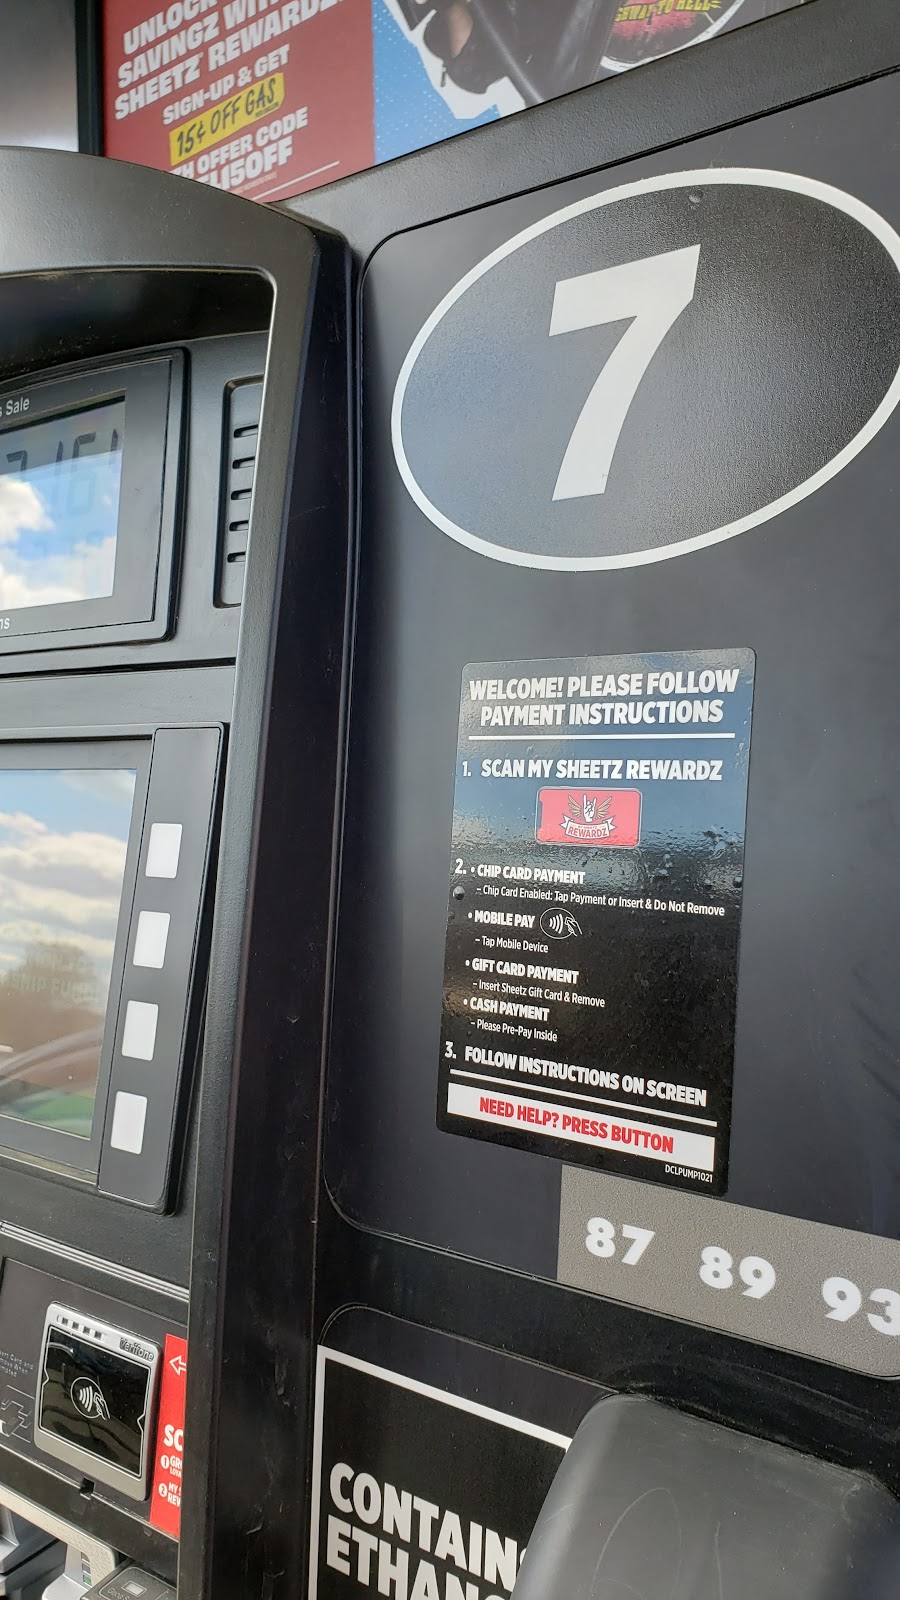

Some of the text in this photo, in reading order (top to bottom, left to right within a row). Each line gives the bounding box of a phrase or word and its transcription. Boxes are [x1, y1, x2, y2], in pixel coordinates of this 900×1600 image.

[117, 0, 276, 88] SAVINGZ WI
[114, 54, 202, 120] SHEETZ
[162, 74, 235, 126] SIGN-UP
[237, 66, 252, 87] &
[254, 44, 290, 78] GET
[210, 95, 242, 134] OFF
[245, 77, 276, 116] GAS
[197, 134, 253, 174] OFFER
[255, 106, 309, 147] CODE
[549, 244, 701, 501] 7
[5, 397, 30, 416] Sale
[469, 668, 740, 701] WELCOME! PLEASE FOLLOW
[480, 699, 724, 726] PAYMENT INSTRUCTIONS
[462, 759, 723, 781] 1. SCAN MY SHEETZ REWARDZ
[568, 826, 607, 838] REWARDZ
[455, 859, 586, 885] 2. CHIP CARD PAYMENT
[483, 885, 725, 916] Chip Card Enabled: Tap Payment or Insert & Do Not Remove
[474, 910, 535, 929] MOBILE PAY
[482, 936, 549, 953] Tap Mobile Device
[472, 959, 579, 985] GIFT CARD PAYMENT
[479, 979, 605, 1008] Insert Sheetz Gift Card & Remove
[470, 996, 550, 1022] CASH PAYMENT
[477, 1019, 558, 1043] Please Pre-Pay Inside
[444, 1041, 707, 1107] 3. FOLLOW INSTRUCTIONS ON SCREEN
[479, 1097, 674, 1154] NEED HELP? PRESS BUTTON
[664, 1164, 713, 1184] DCLPUMP1021
[585, 1216, 900, 1336] 87 89 93
[119, 1337, 155, 1362] Verifone
[330, 1462, 527, 1592] CONTAIN
[326, 1514, 508, 1600] ETHAN
